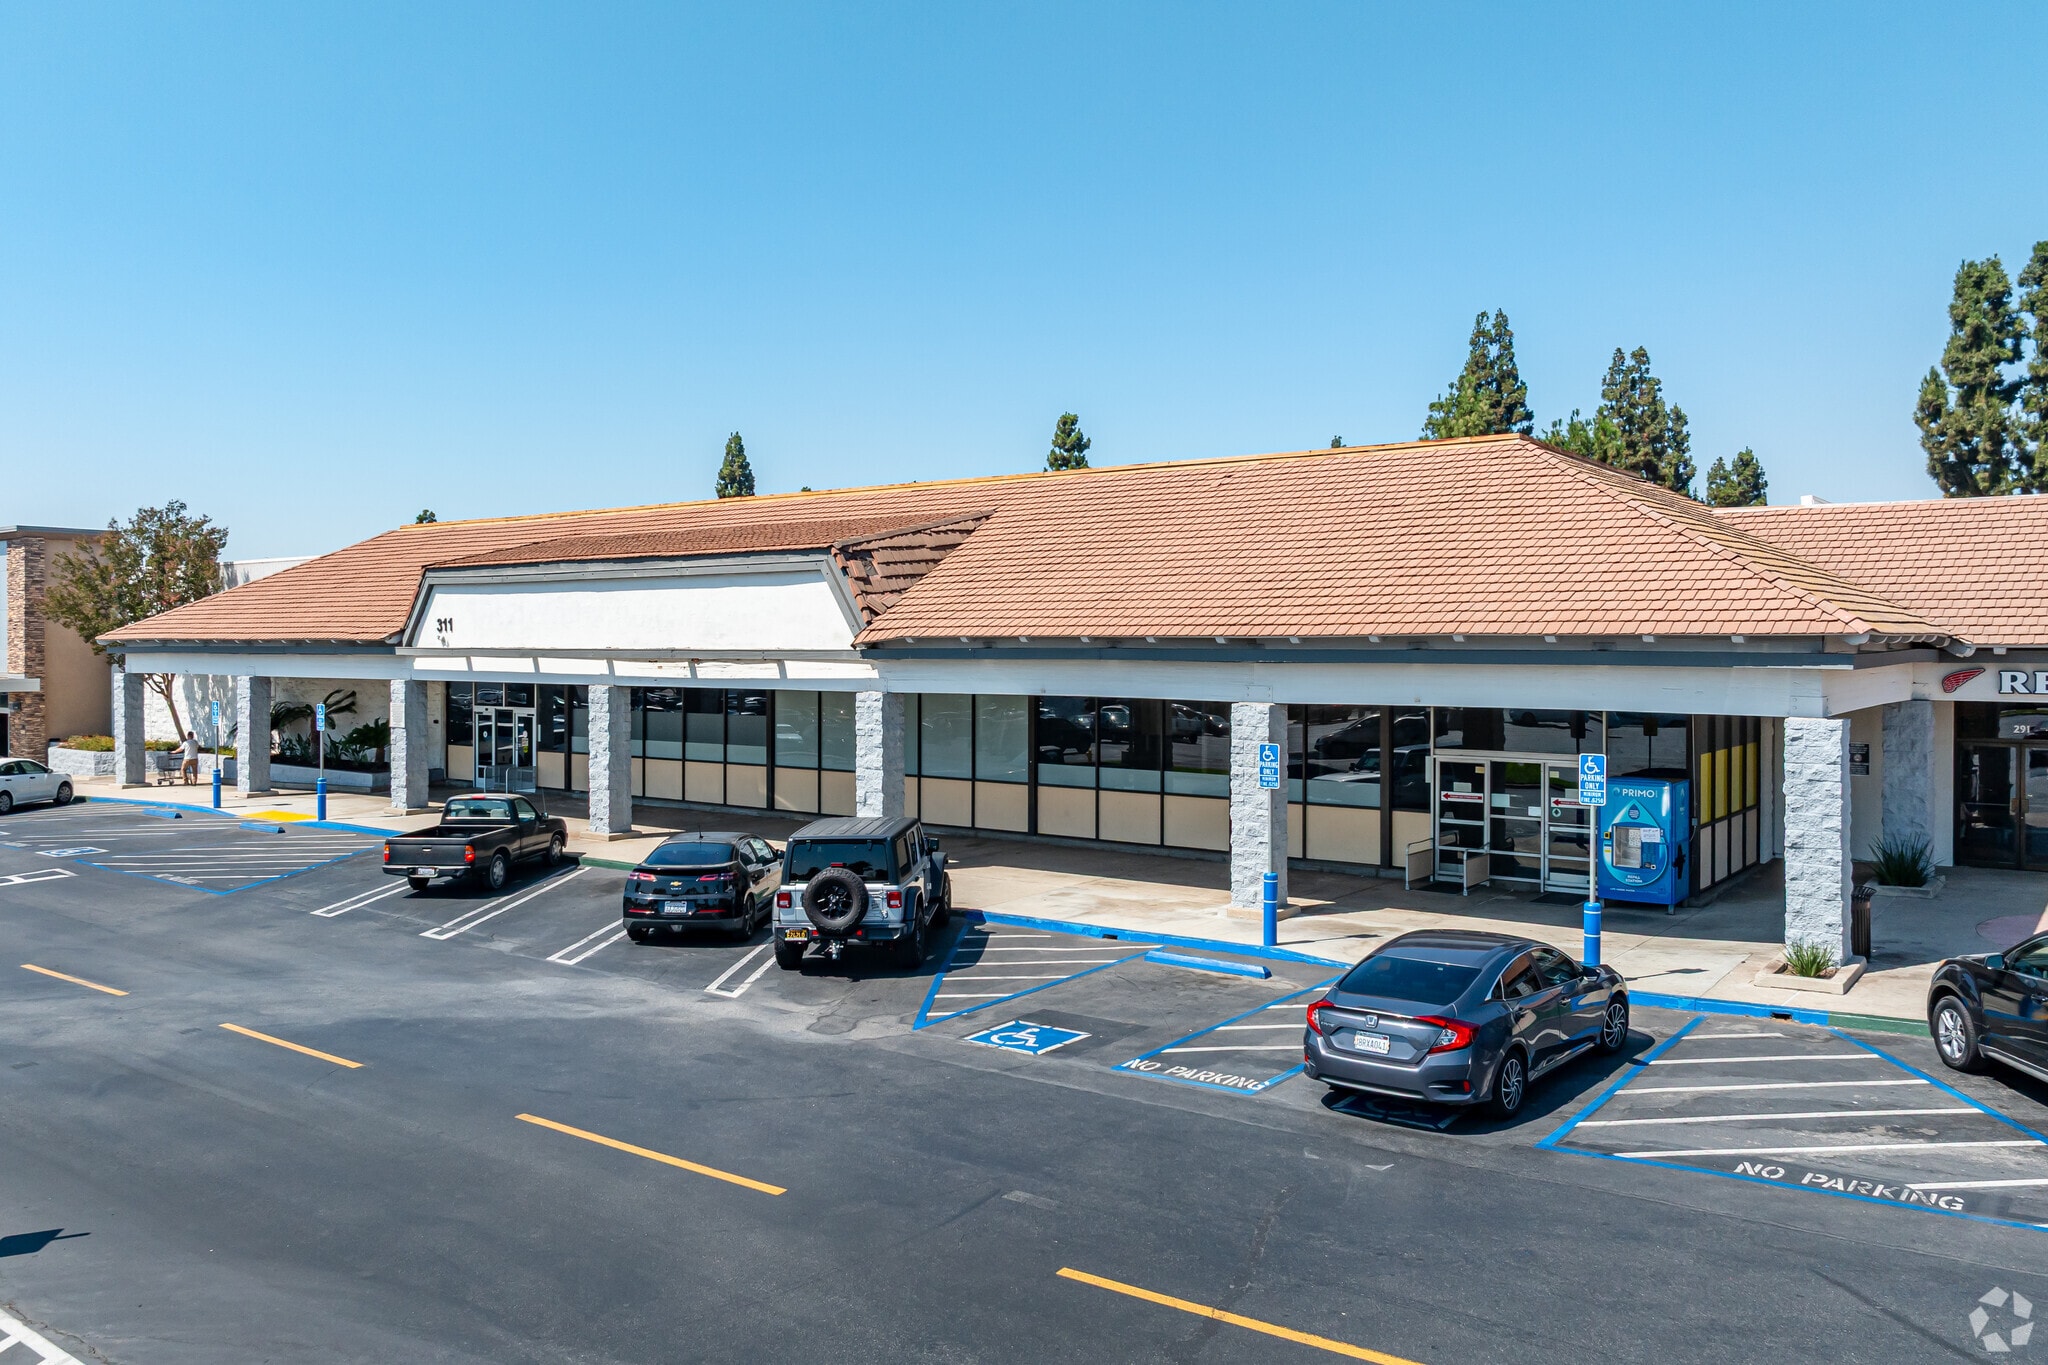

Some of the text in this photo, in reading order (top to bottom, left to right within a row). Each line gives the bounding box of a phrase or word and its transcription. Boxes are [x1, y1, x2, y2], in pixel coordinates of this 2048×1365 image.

[436, 617, 453, 633] 311
[2013, 725, 2030, 734] 291
[1580, 774, 1604, 783] PARKING
[1584, 782, 1600, 790] ONLY
[1622, 788, 1655, 798] PRIMO
[1121, 1058, 1270, 1091] NO PARKING
[1733, 1161, 1965, 1211] NO PARKING
